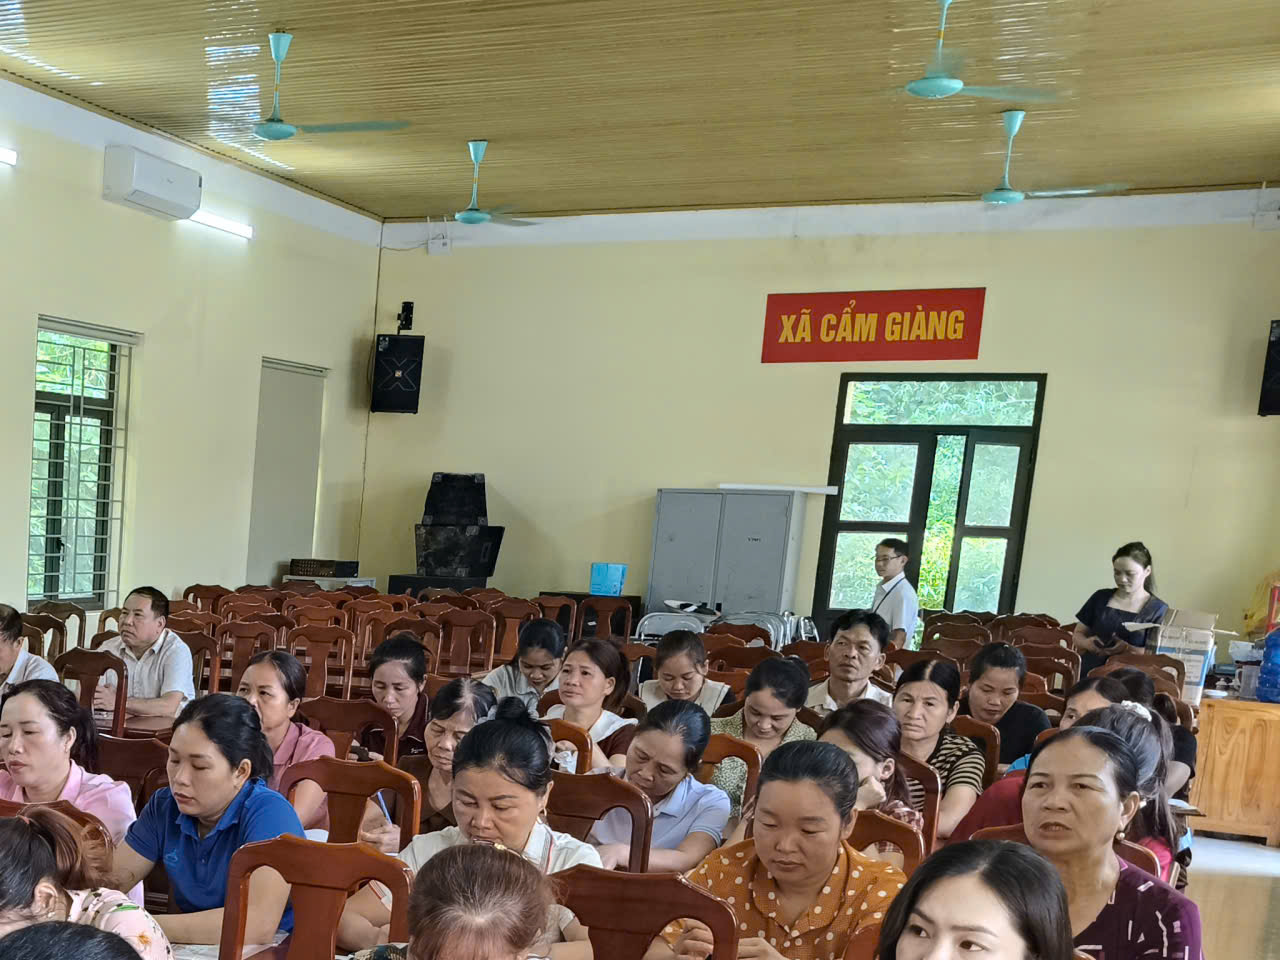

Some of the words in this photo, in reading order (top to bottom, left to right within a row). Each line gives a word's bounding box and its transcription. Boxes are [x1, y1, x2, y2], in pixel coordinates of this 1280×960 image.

[778, 308, 812, 343] XÃ
[820, 299, 879, 343] CẨM
[884, 304, 966, 342] GIÀNG
